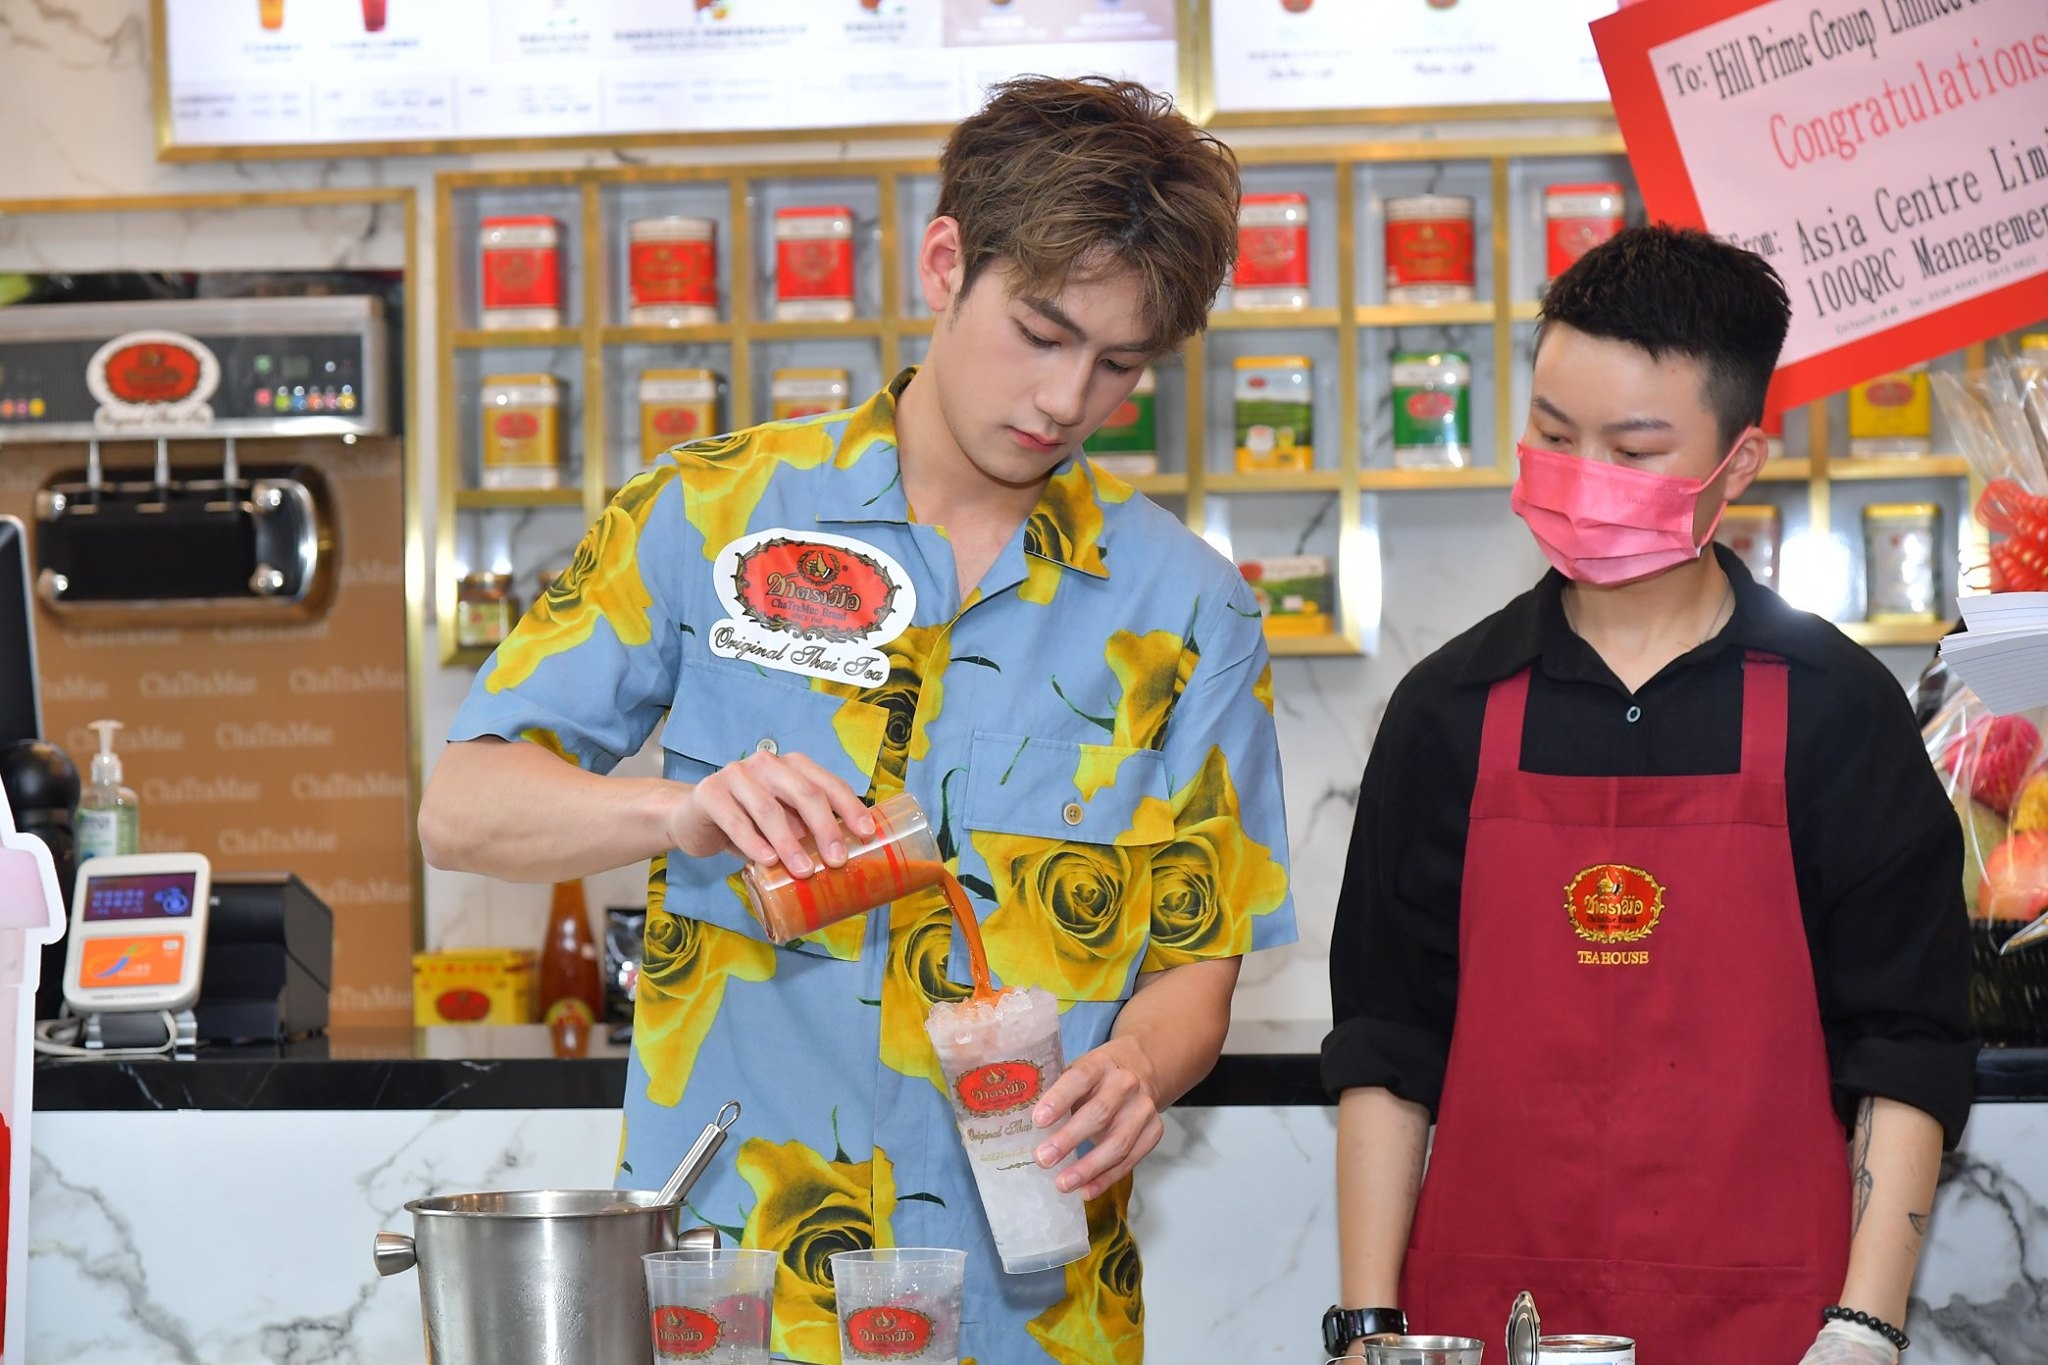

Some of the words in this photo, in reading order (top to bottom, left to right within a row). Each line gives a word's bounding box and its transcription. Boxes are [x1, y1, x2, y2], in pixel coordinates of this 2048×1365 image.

[1667, 61, 1709, 97] To:
[1706, 39, 1754, 99] Hill
[1747, 27, 1813, 84] Prime
[1808, 8, 1878, 60] Group
[1768, 32, 2048, 170] Congratulations
[1796, 207, 1867, 265] Asia
[1874, 169, 1983, 234] Centre
[1988, 127, 2048, 192] Lim
[1806, 247, 1905, 318] 100QRC
[713, 626, 791, 661] Original
[790, 645, 842, 672] Thai
[843, 656, 884, 681] Tea
